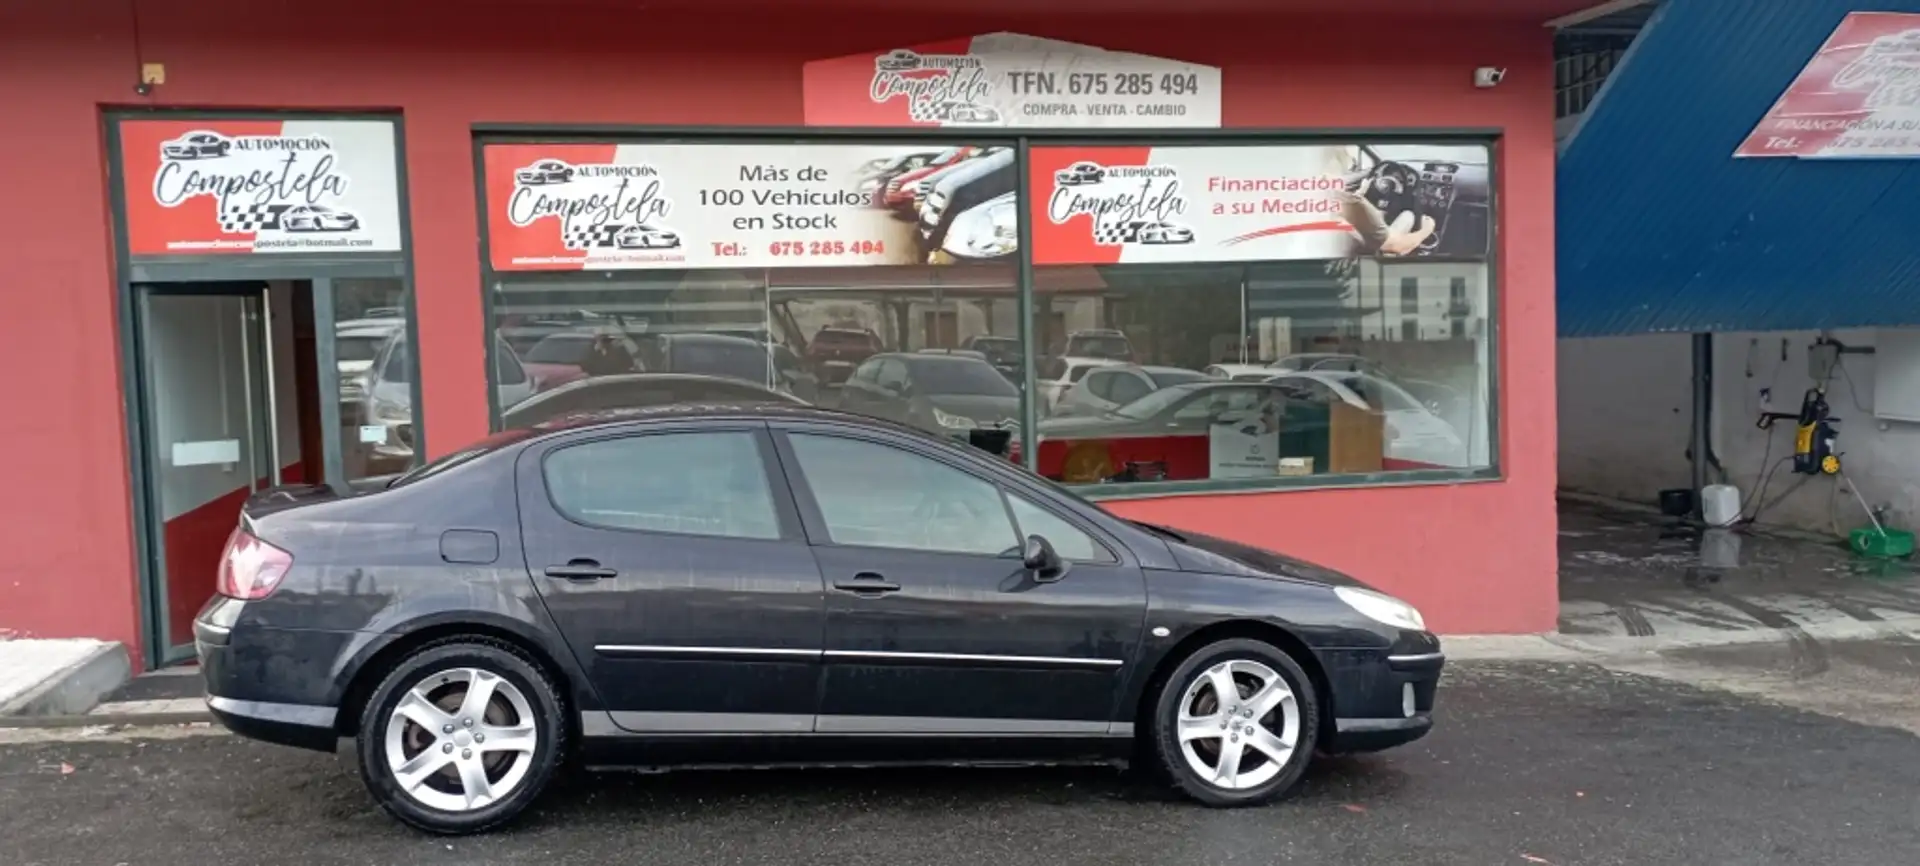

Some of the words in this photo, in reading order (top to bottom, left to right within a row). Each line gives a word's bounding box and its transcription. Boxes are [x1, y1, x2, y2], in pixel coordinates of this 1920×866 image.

[872, 65, 990, 108] Compostela
[1007, 72, 1062, 95] TFN.
[1068, 73, 1108, 95] 675
[1114, 73, 1153, 95] 285
[1160, 73, 1198, 95] 494
[1023, 103, 1078, 116] COMPRA
[1087, 103, 1126, 116] VENTA
[1136, 103, 1187, 116] CAMBIO
[234, 136, 330, 150] AUTOMOCIÓN
[577, 164, 657, 177] AUTOMOCIÓN
[739, 165, 789, 181] Más
[796, 165, 828, 181] de
[1108, 167, 1176, 178] AUTOMOCIÓN
[156, 152, 347, 214] Compostela
[1208, 174, 1344, 192] Financiación
[511, 178, 670, 232] Compostela
[699, 189, 744, 206] 100
[1050, 178, 1188, 229] Compostela
[1212, 202, 1225, 215] a
[1231, 202, 1254, 215] su
[1262, 198, 1341, 213] Medida
[733, 216, 764, 230] en
[771, 213, 837, 230] Stock
[712, 242, 747, 256] Tel.:
[769, 241, 804, 256] 675
[810, 240, 845, 255] 285
[850, 239, 885, 254] 494
